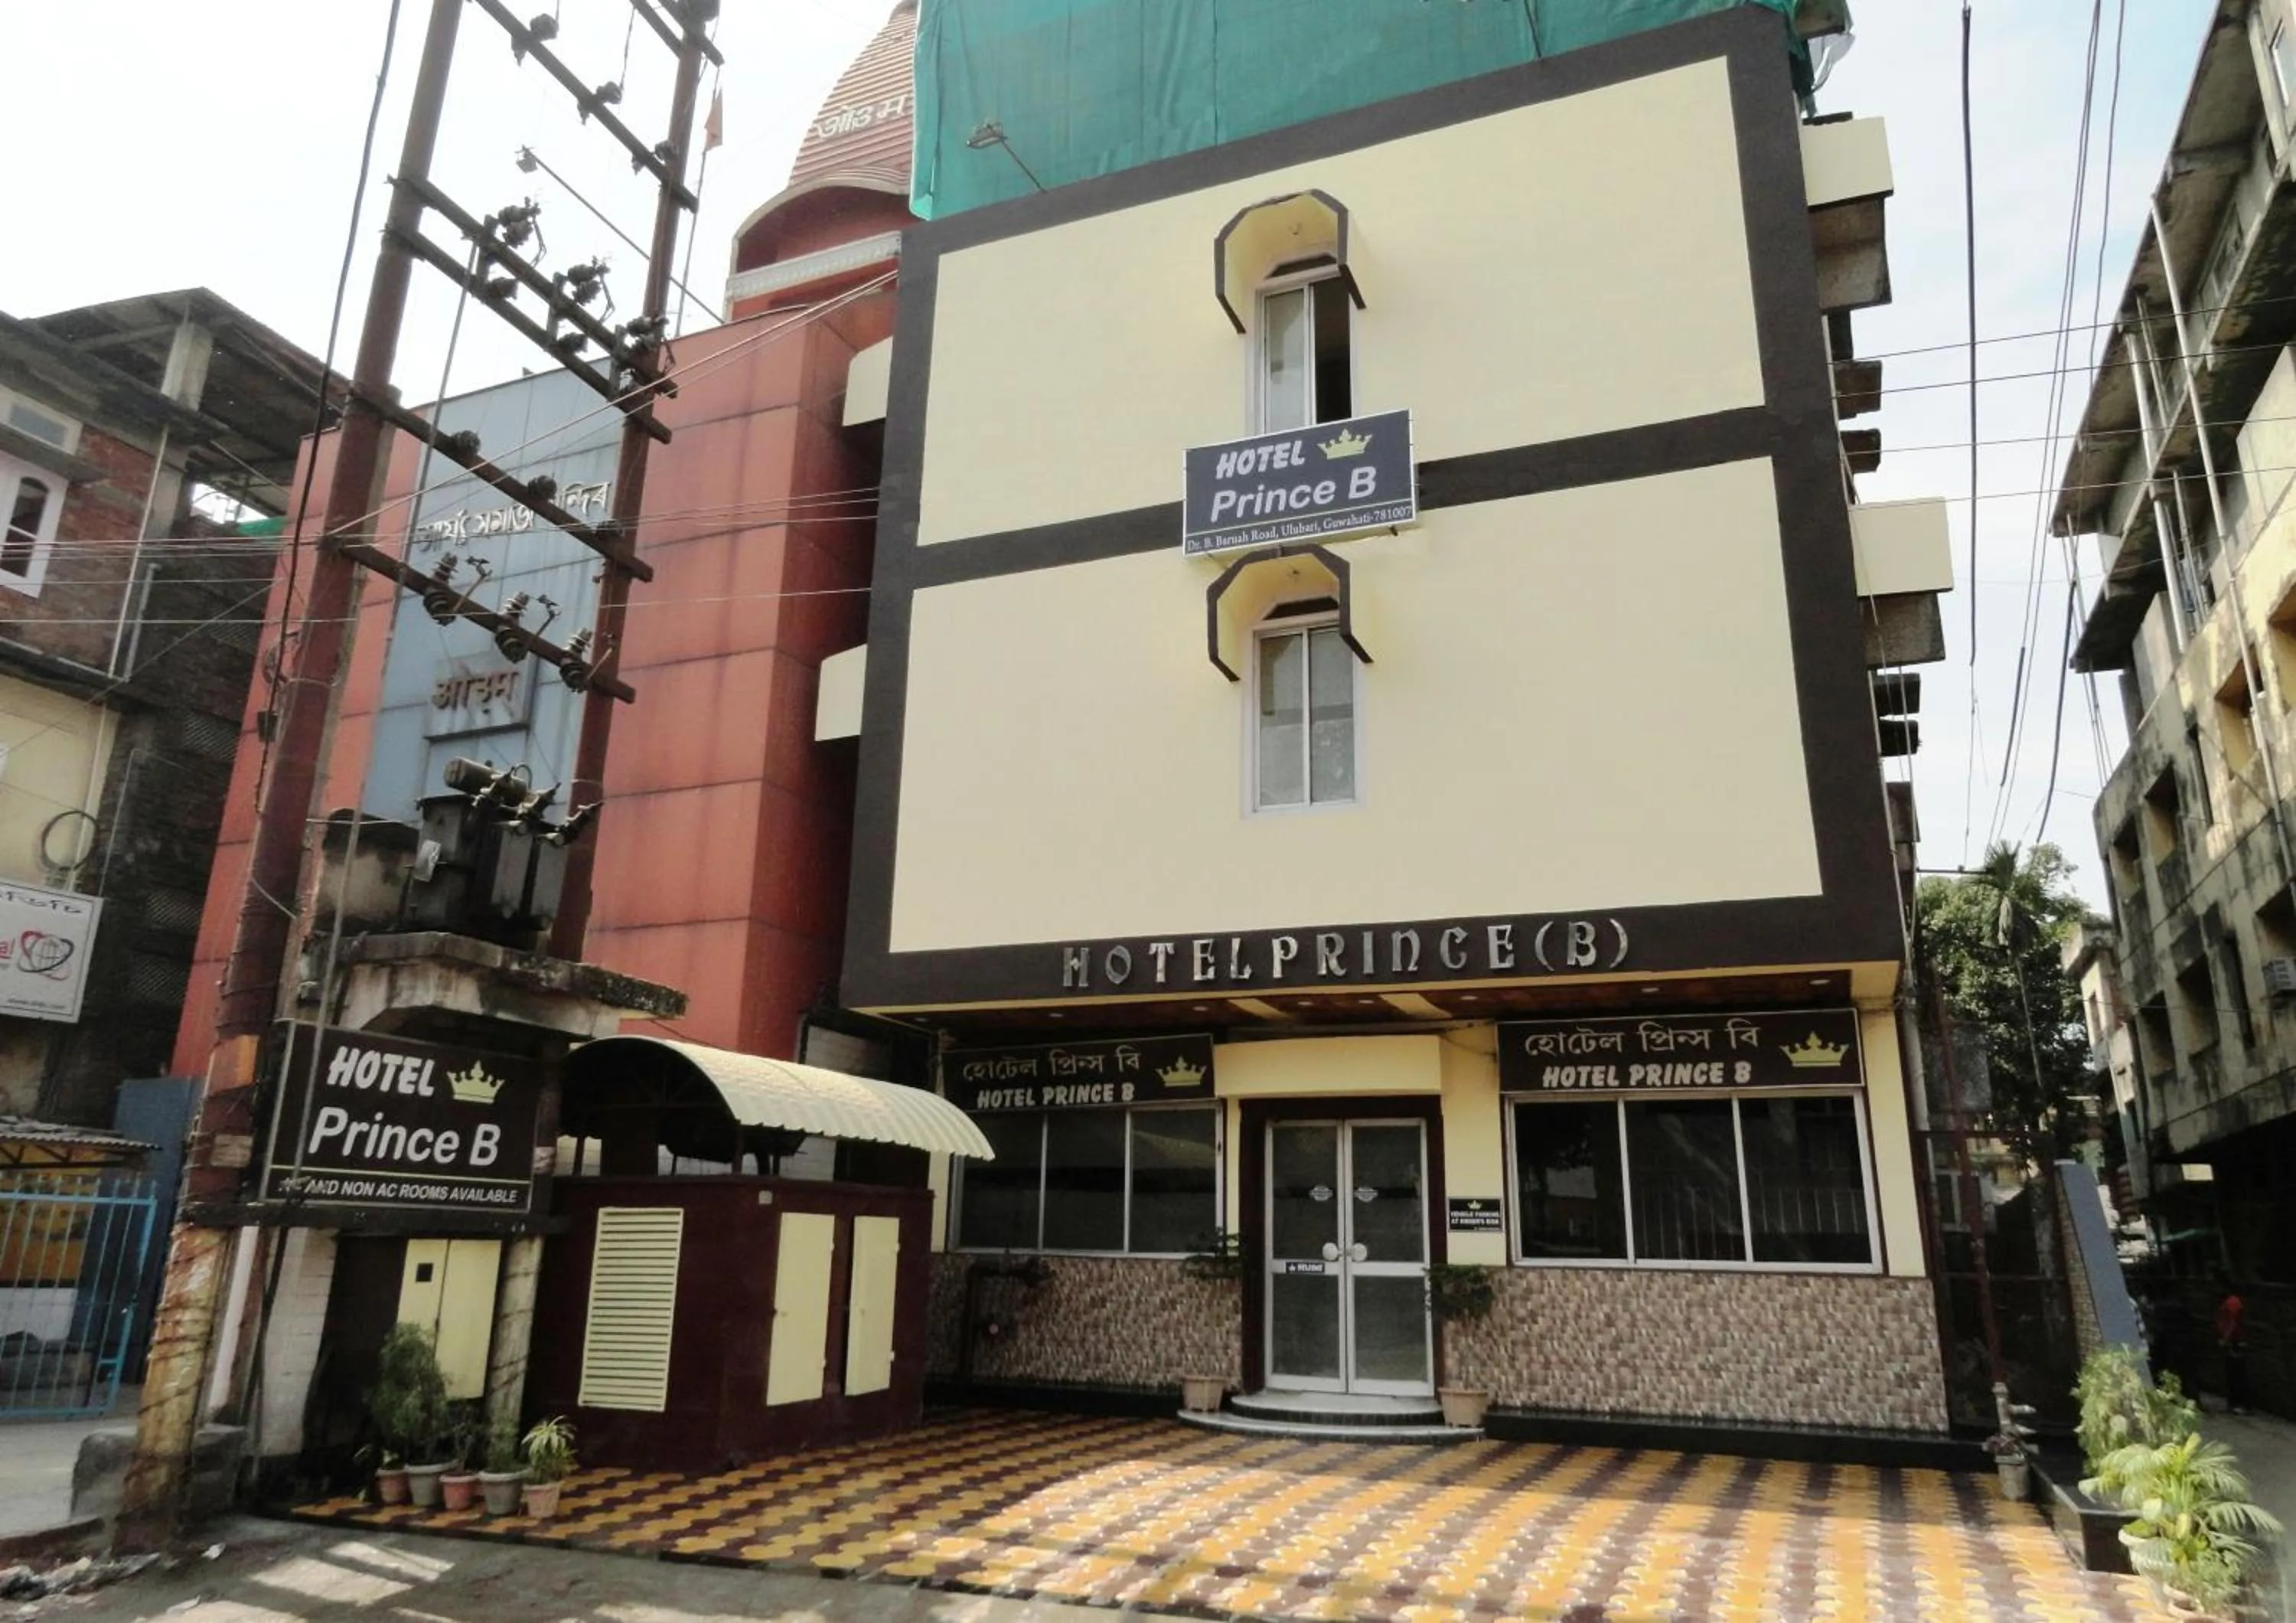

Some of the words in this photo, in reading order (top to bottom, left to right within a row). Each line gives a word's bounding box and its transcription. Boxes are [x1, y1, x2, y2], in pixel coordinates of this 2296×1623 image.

[1215, 440, 1306, 481] HOTEL
[1210, 479, 1337, 523] Prince
[1348, 465, 1378, 500] B
[1251, 526, 1279, 541] Road,
[1534, 919, 1629, 972] (B)
[1525, 1025, 1626, 1056] হোটেল
[1724, 1017, 1762, 1050] বি
[327, 1045, 436, 1097] HOTEL
[962, 1056, 1039, 1083] হোটেল
[1114, 1044, 1143, 1073] বি
[1542, 1065, 1620, 1088] HOTEL
[1629, 1061, 1724, 1087] PRINCE
[977, 1086, 1036, 1110] HOTEL
[1042, 1083, 1115, 1106] PRINCE
[1120, 1081, 1137, 1102] B
[308, 1105, 459, 1165] Prince
[468, 1122, 502, 1167] B
[340, 1181, 375, 1197] NON
[376, 1183, 397, 1197] AC
[399, 1184, 449, 1200] ROOMS
[449, 1187, 519, 1203] AVAILABLE
